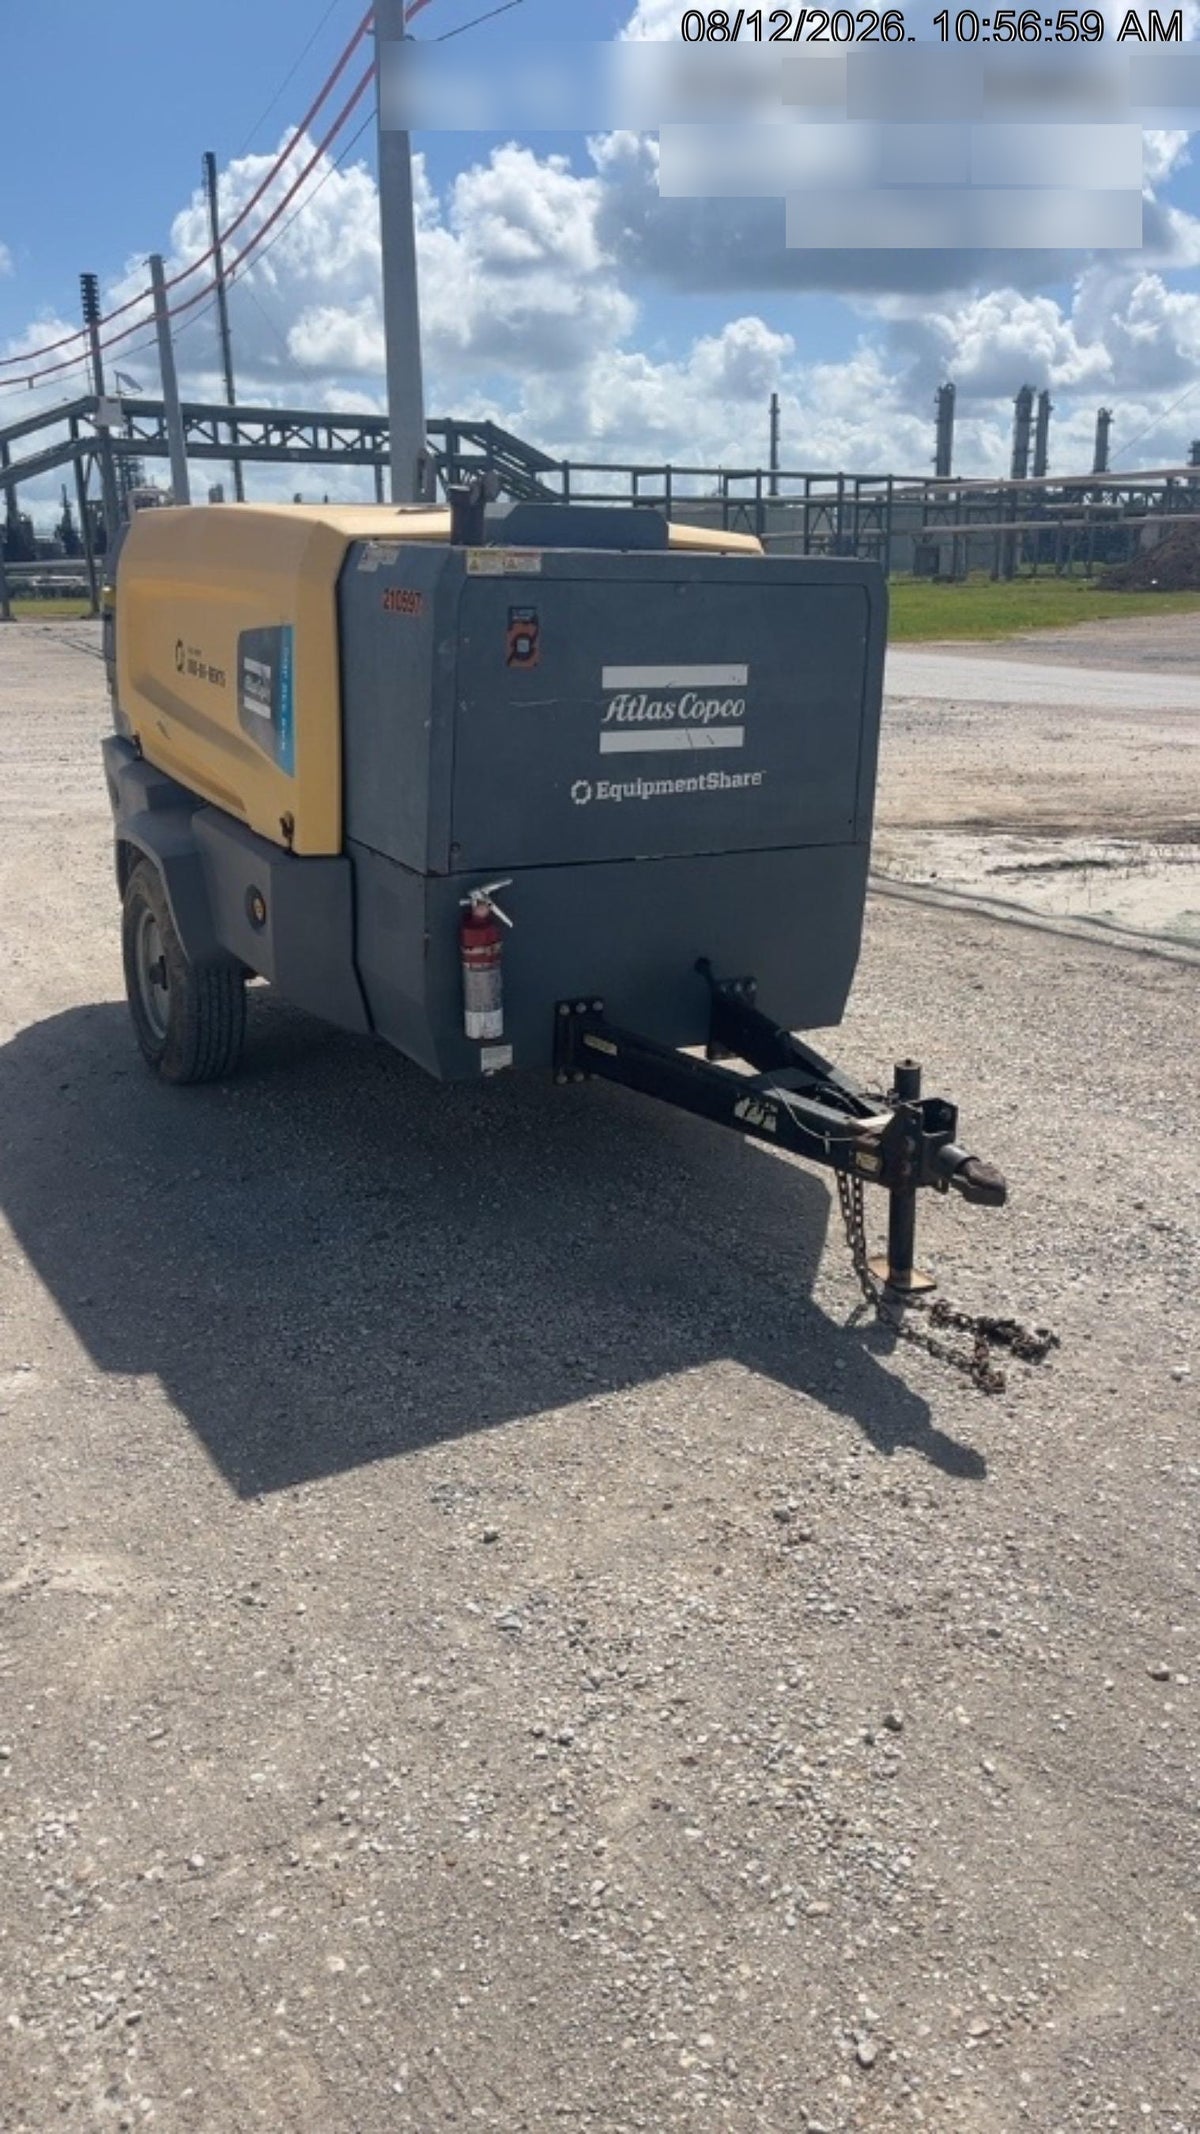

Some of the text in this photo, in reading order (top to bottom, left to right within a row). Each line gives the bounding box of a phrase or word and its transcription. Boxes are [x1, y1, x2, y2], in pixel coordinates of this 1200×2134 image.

[602, 692, 746, 723] Atlas Copco
[595, 771, 763, 802] EquipmentShare
